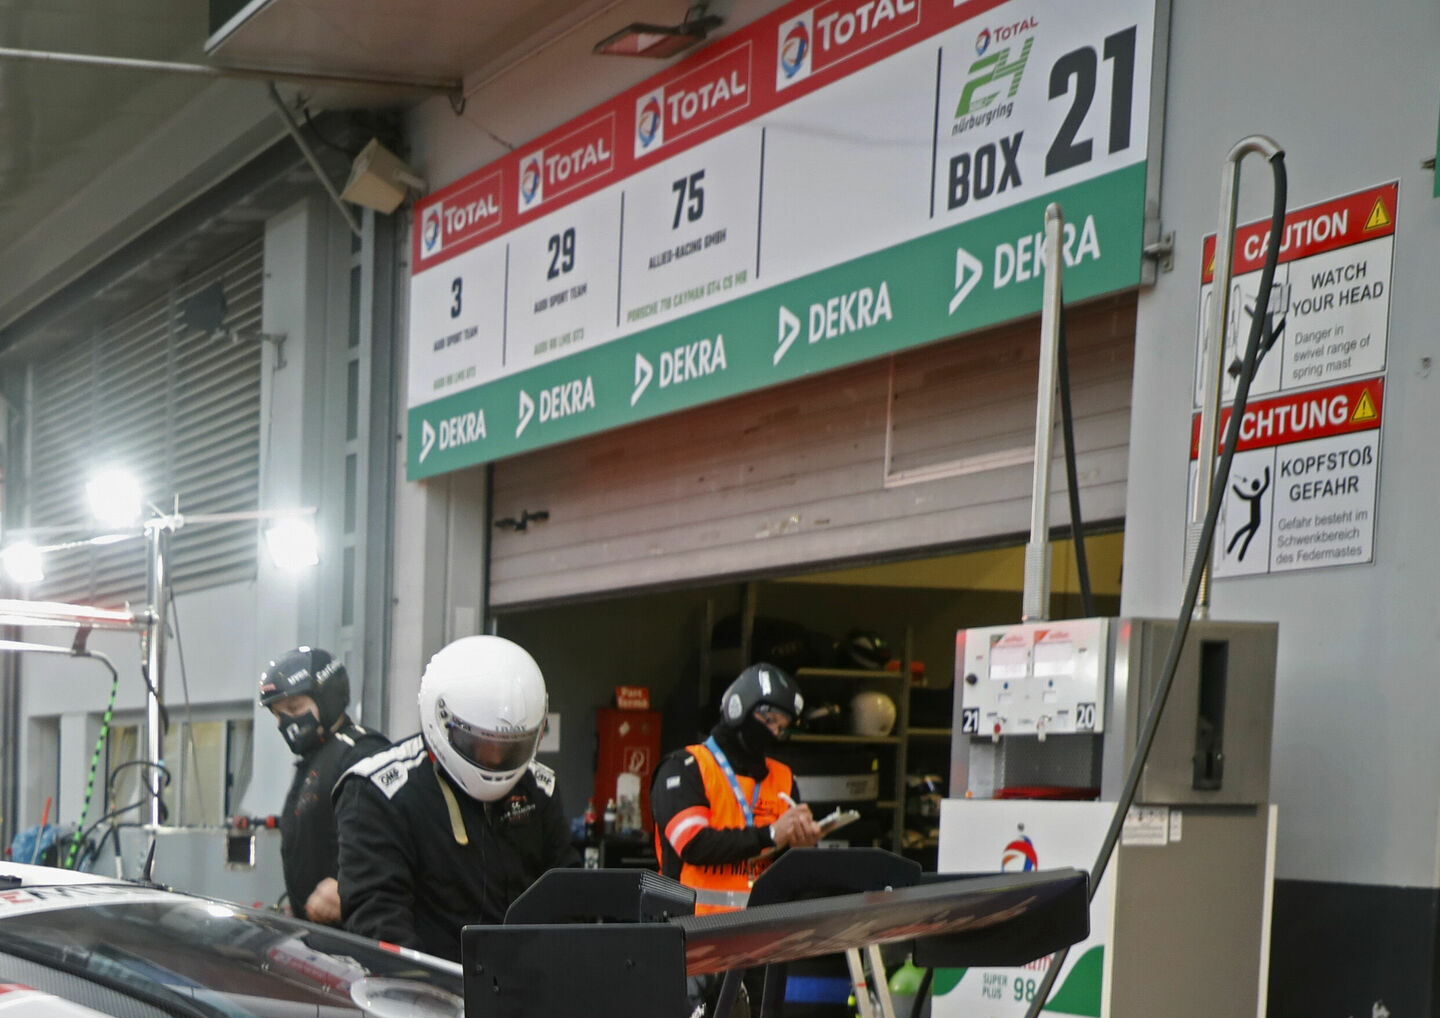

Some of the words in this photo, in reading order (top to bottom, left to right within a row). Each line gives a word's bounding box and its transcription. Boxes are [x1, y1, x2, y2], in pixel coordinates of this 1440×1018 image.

[993, 16, 1038, 44] TOTAL
[667, 70, 746, 125] TOTAL
[947, 130, 1024, 211] BOX
[1044, 24, 1138, 177] 21
[951, 101, 1014, 136] nürburgring
[545, 137, 610, 186] TOTAL
[444, 193, 499, 235] TOTAL
[672, 168, 706, 230] 75
[547, 227, 576, 281] 29
[1311, 260, 1368, 291] WATCH
[450, 276, 463, 319] 3
[549, 290, 569, 310] SPORT
[570, 283, 587, 303] TEAM
[808, 280, 893, 345] DEKRA
[1292, 293, 1335, 318] YOUR
[1338, 281, 1384, 308] HEAD
[1293, 345, 1325, 363] swivel
[1327, 339, 1358, 357] range
[1359, 334, 1372, 349] of
[1294, 326, 1332, 346] Danger
[1333, 323, 1345, 336] in
[659, 333, 727, 389] DEKRA
[1292, 362, 1323, 380] spring
[1325, 358, 1352, 373] mast
[539, 375, 595, 423] DEKRA
[439, 409, 486, 451] DEKRA
[1280, 445, 1373, 478] KOPFSTOß
[1289, 475, 1359, 502] GEFAHR
[1278, 516, 1312, 531] Gefahr
[1314, 510, 1353, 528] besteht
[1354, 510, 1368, 522] im
[1277, 527, 1361, 548] Schwenkbereich
[1276, 552, 1294, 565] des
[1296, 545, 1362, 562] Federmastes
[962, 709, 979, 734] 21
[1076, 704, 1096, 730] 20
[982, 986, 1003, 999] PLUS
[1013, 976, 1037, 1003] 98
[983, 972, 1008, 987] SUPER
